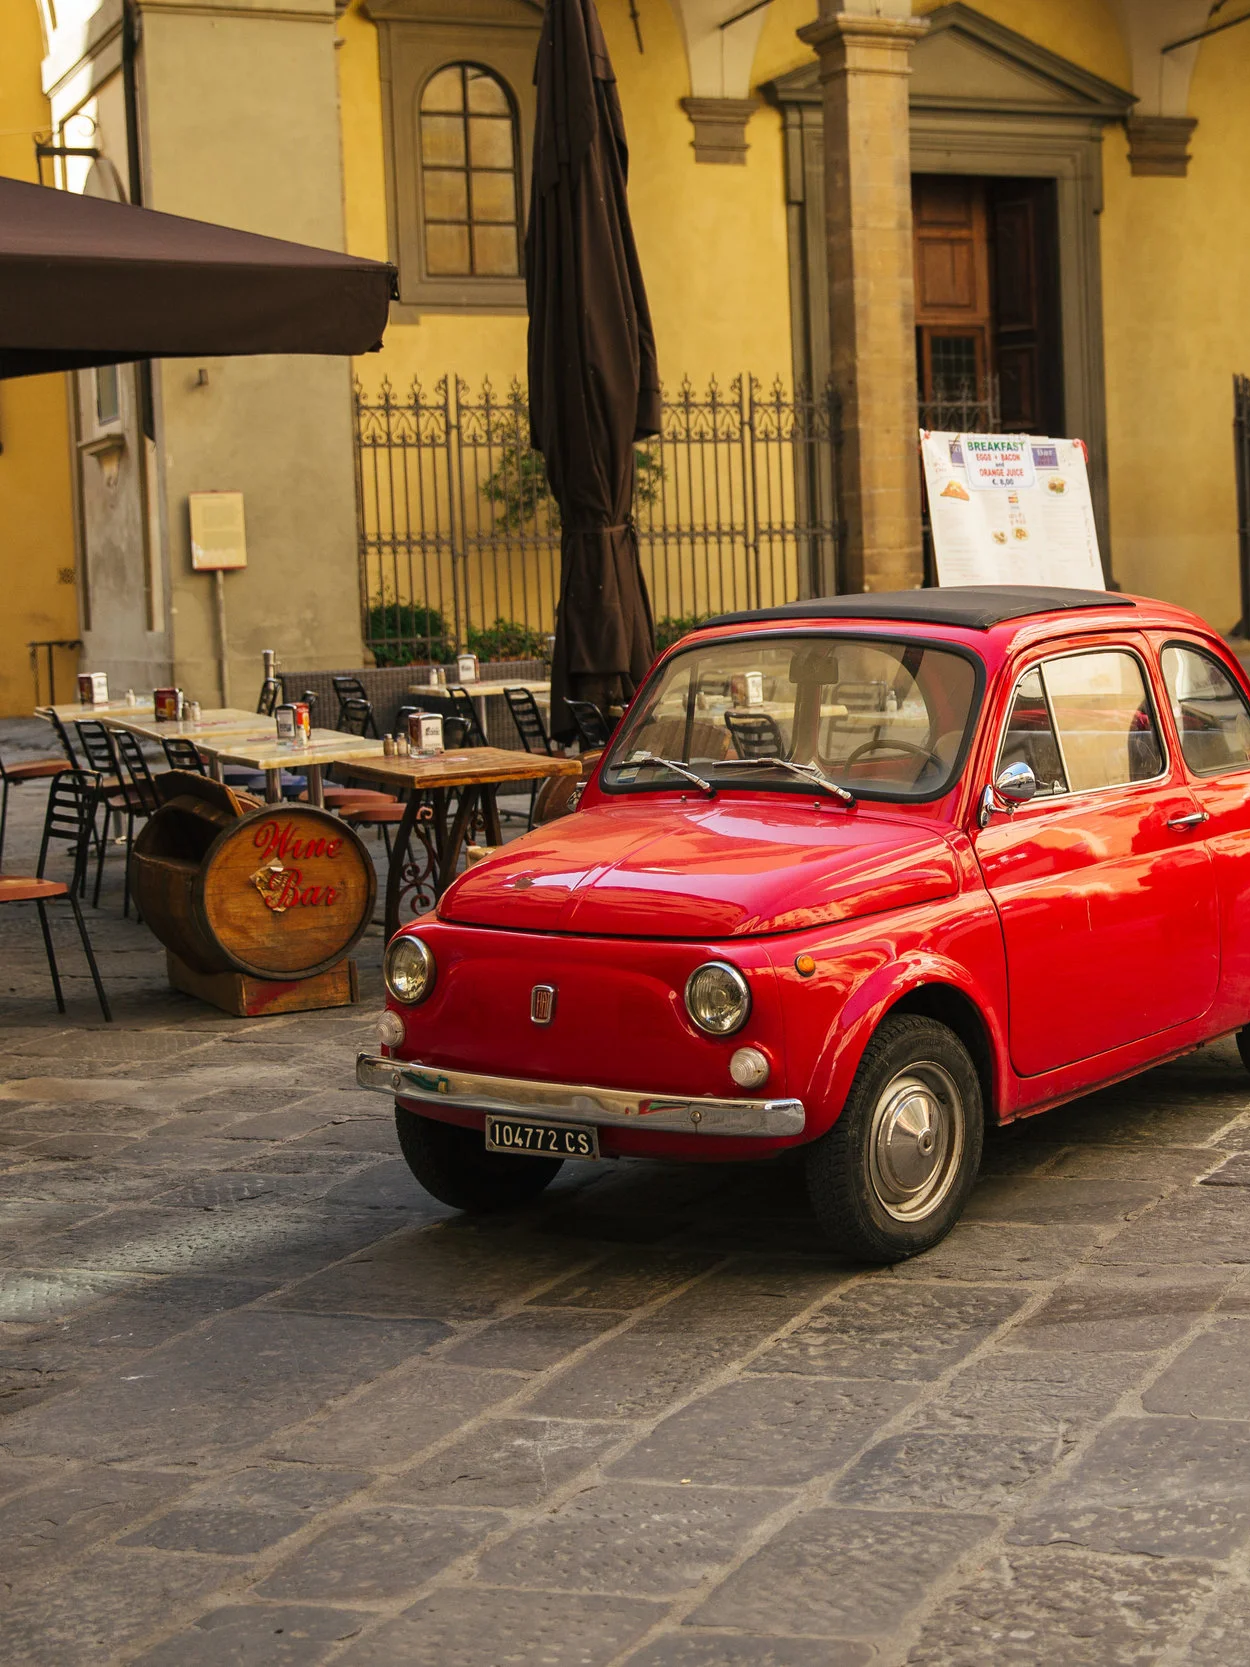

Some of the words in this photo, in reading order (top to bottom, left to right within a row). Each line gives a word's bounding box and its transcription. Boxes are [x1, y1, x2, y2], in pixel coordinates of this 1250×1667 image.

[967, 441, 1025, 451] BREAKFAST
[976, 453, 991, 461] EGGS
[1001, 453, 1021, 461] BACON
[979, 468, 1004, 476] ORANGE
[1007, 468, 1024, 476] JUICE
[255, 820, 343, 859] Wine
[265, 868, 339, 908] Bar
[536, 991, 550, 1018] FIAT
[495, 1124, 558, 1150] 104772
[565, 1132, 589, 1153] CS
